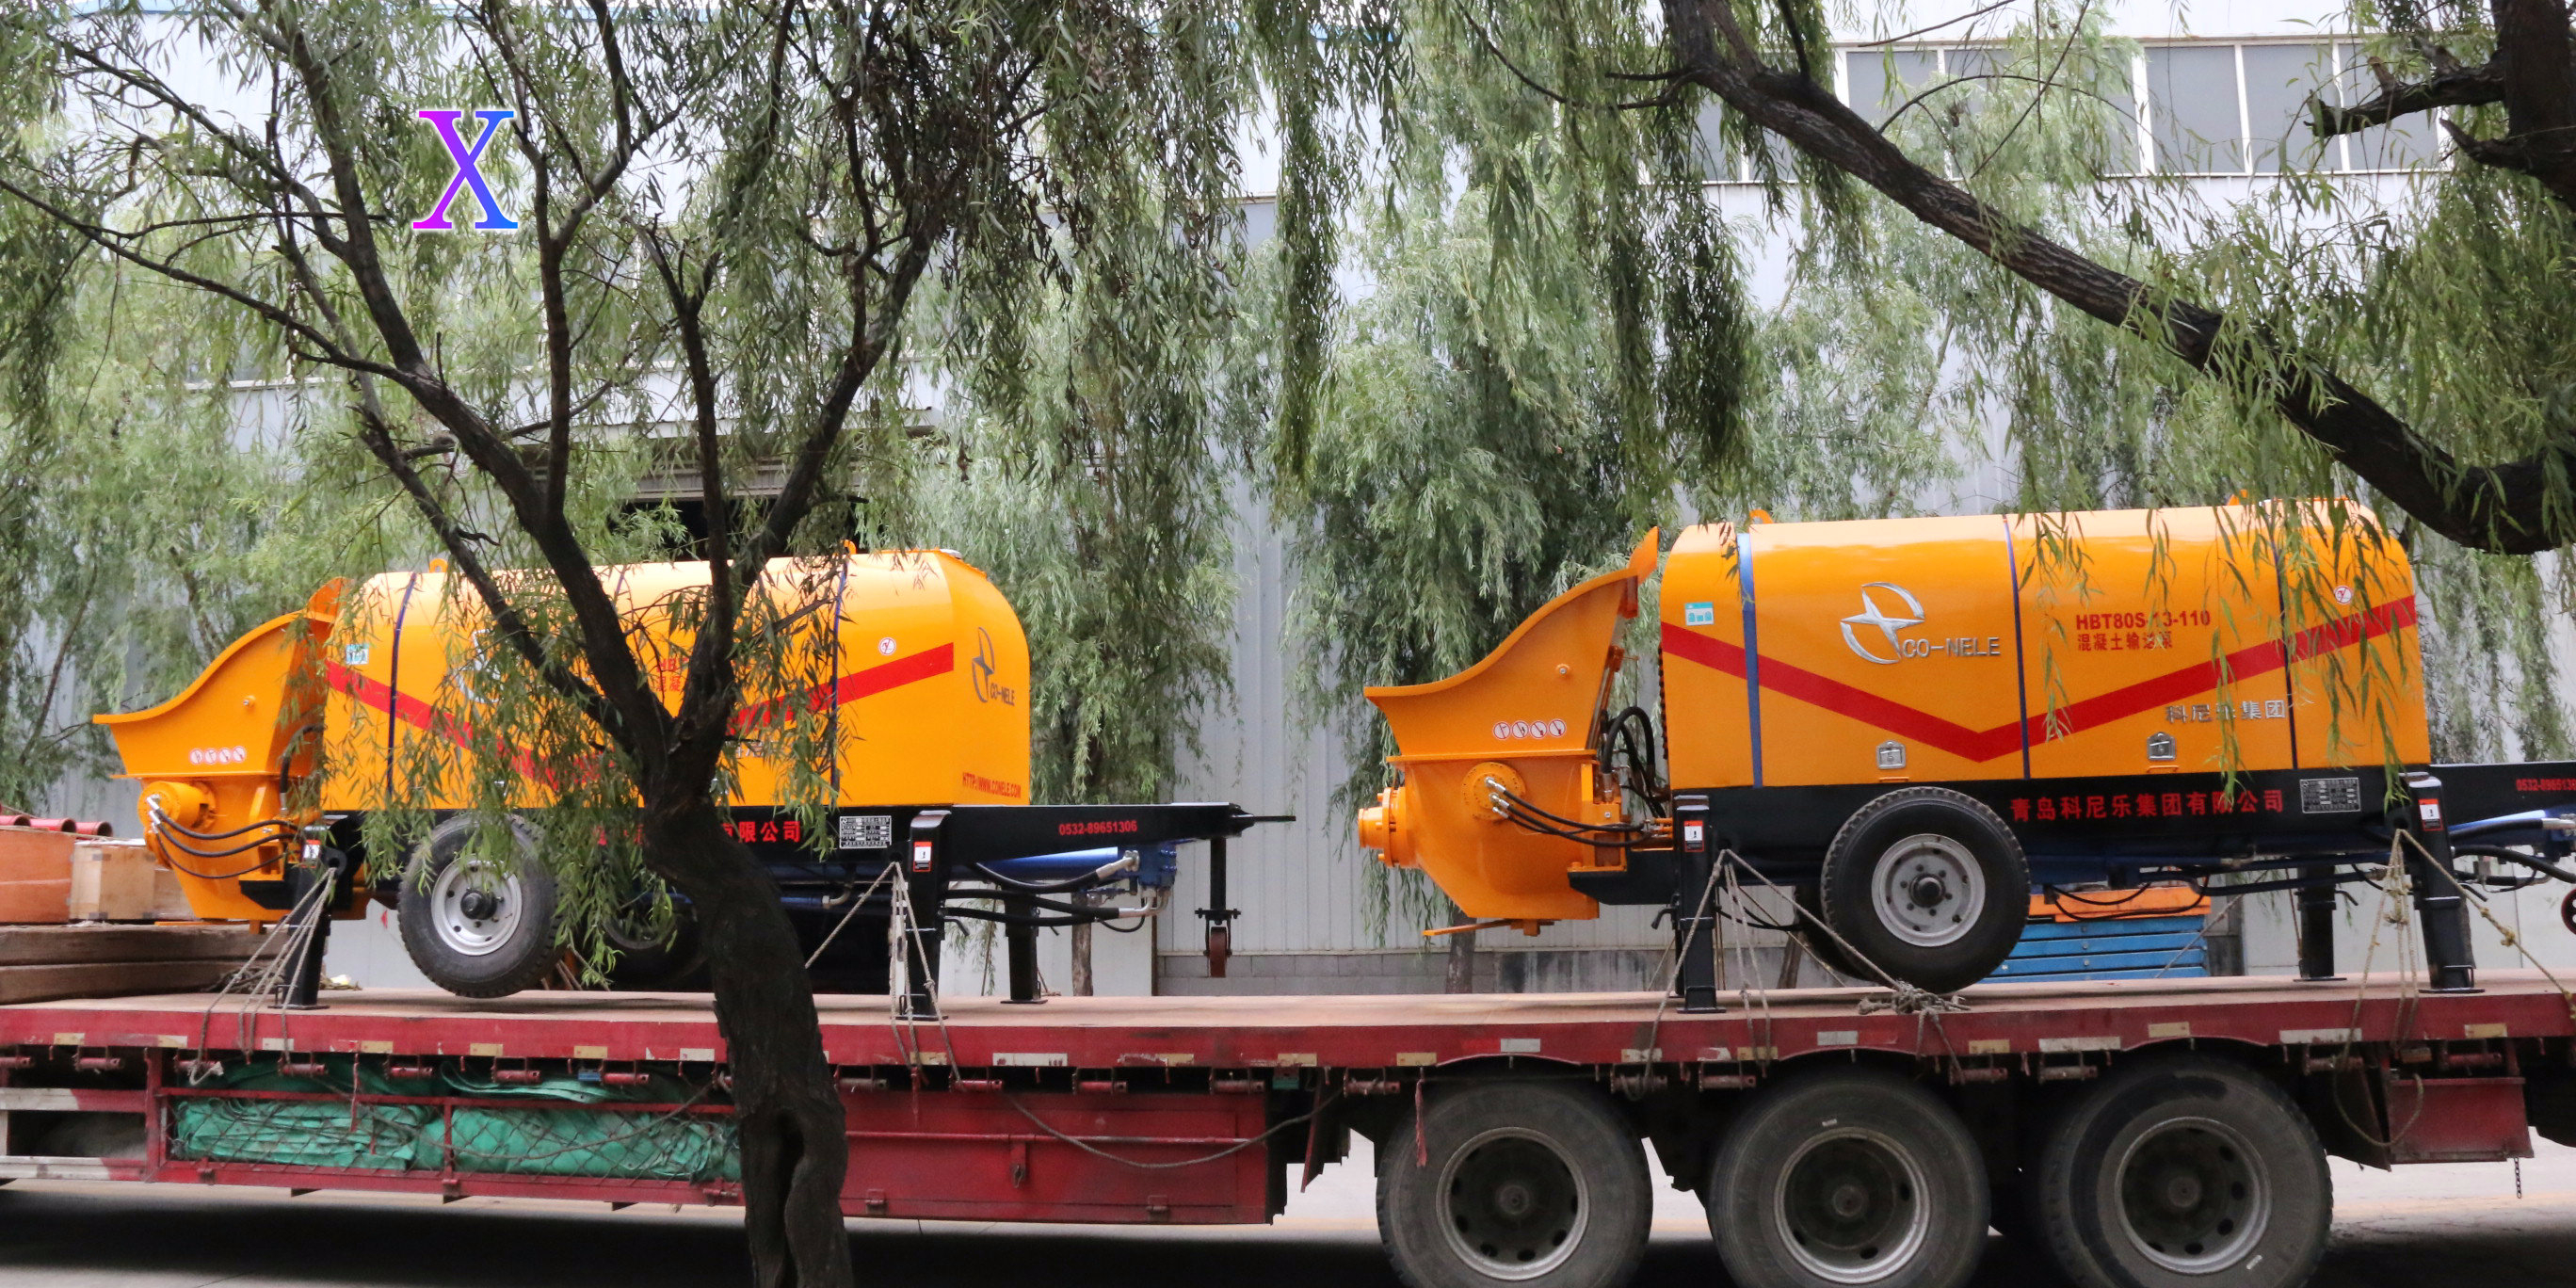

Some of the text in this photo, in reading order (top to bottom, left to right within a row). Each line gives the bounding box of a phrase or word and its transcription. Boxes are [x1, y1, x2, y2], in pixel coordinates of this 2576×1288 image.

[1903, 636, 2001, 658] CO-NELE
[990, 683, 1015, 706] CO-NELE
[2010, 789, 2284, 822] 青岛科尼乐集团有限公司
[1058, 820, 1138, 836] 0532-89651306
